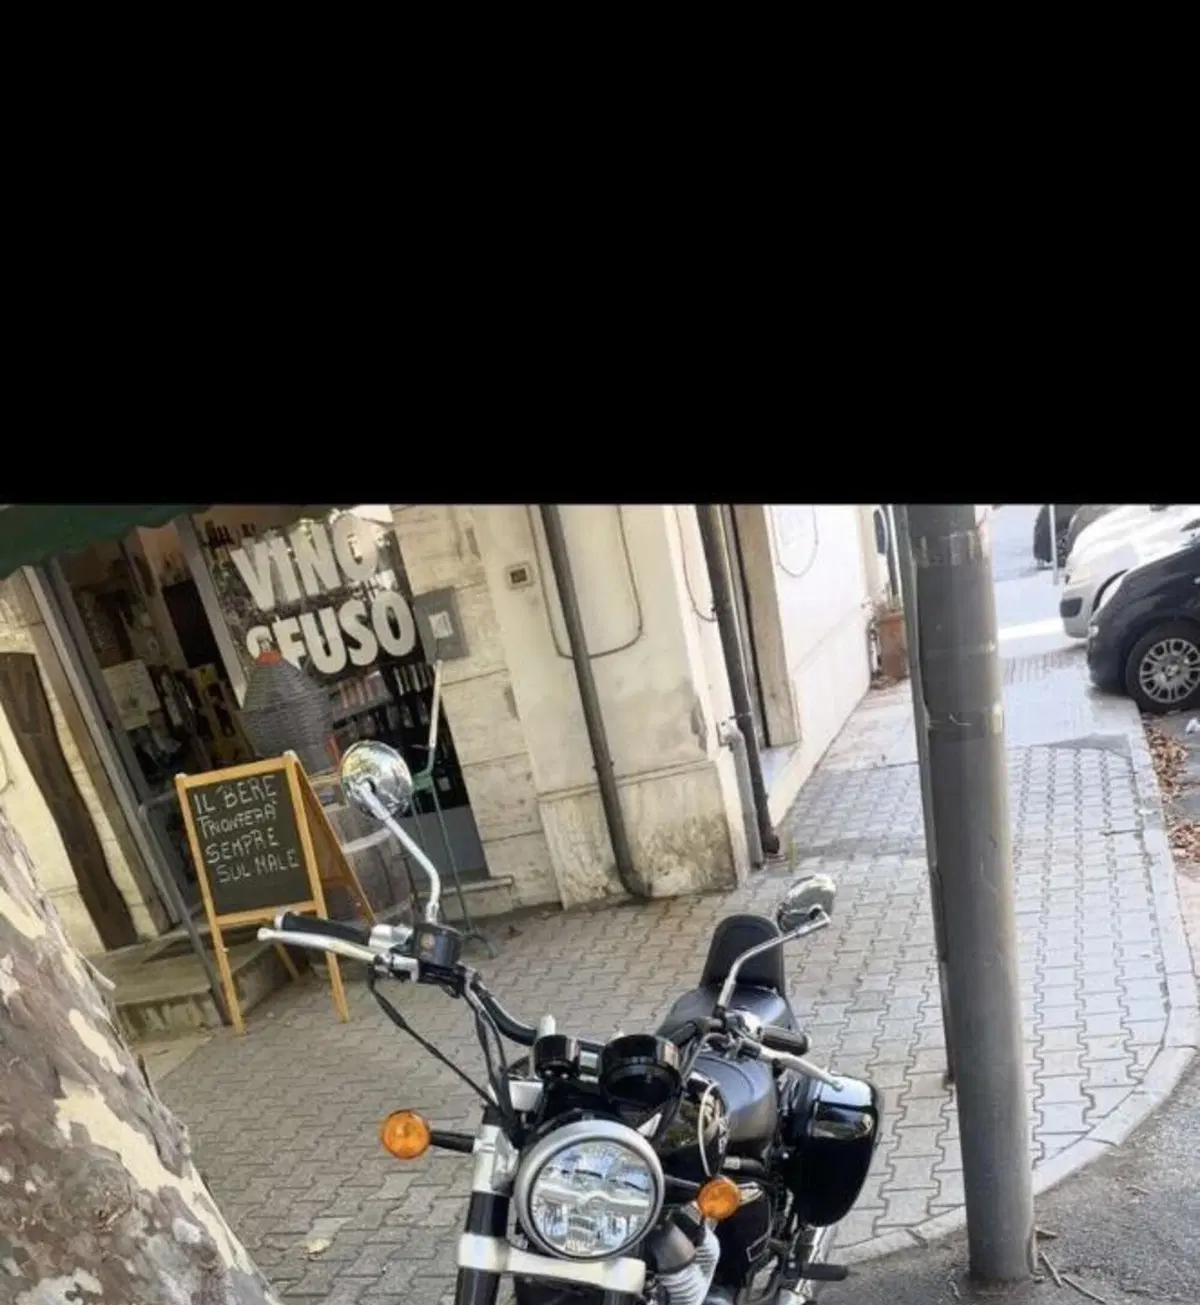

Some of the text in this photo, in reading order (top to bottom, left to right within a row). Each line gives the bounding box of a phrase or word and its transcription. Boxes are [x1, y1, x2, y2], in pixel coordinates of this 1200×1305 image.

[229, 514, 378, 612] VINO
[193, 775, 278, 814] IL BERE
[205, 827, 280, 864] SEMPRE
[216, 849, 300, 884] SUL MALE
